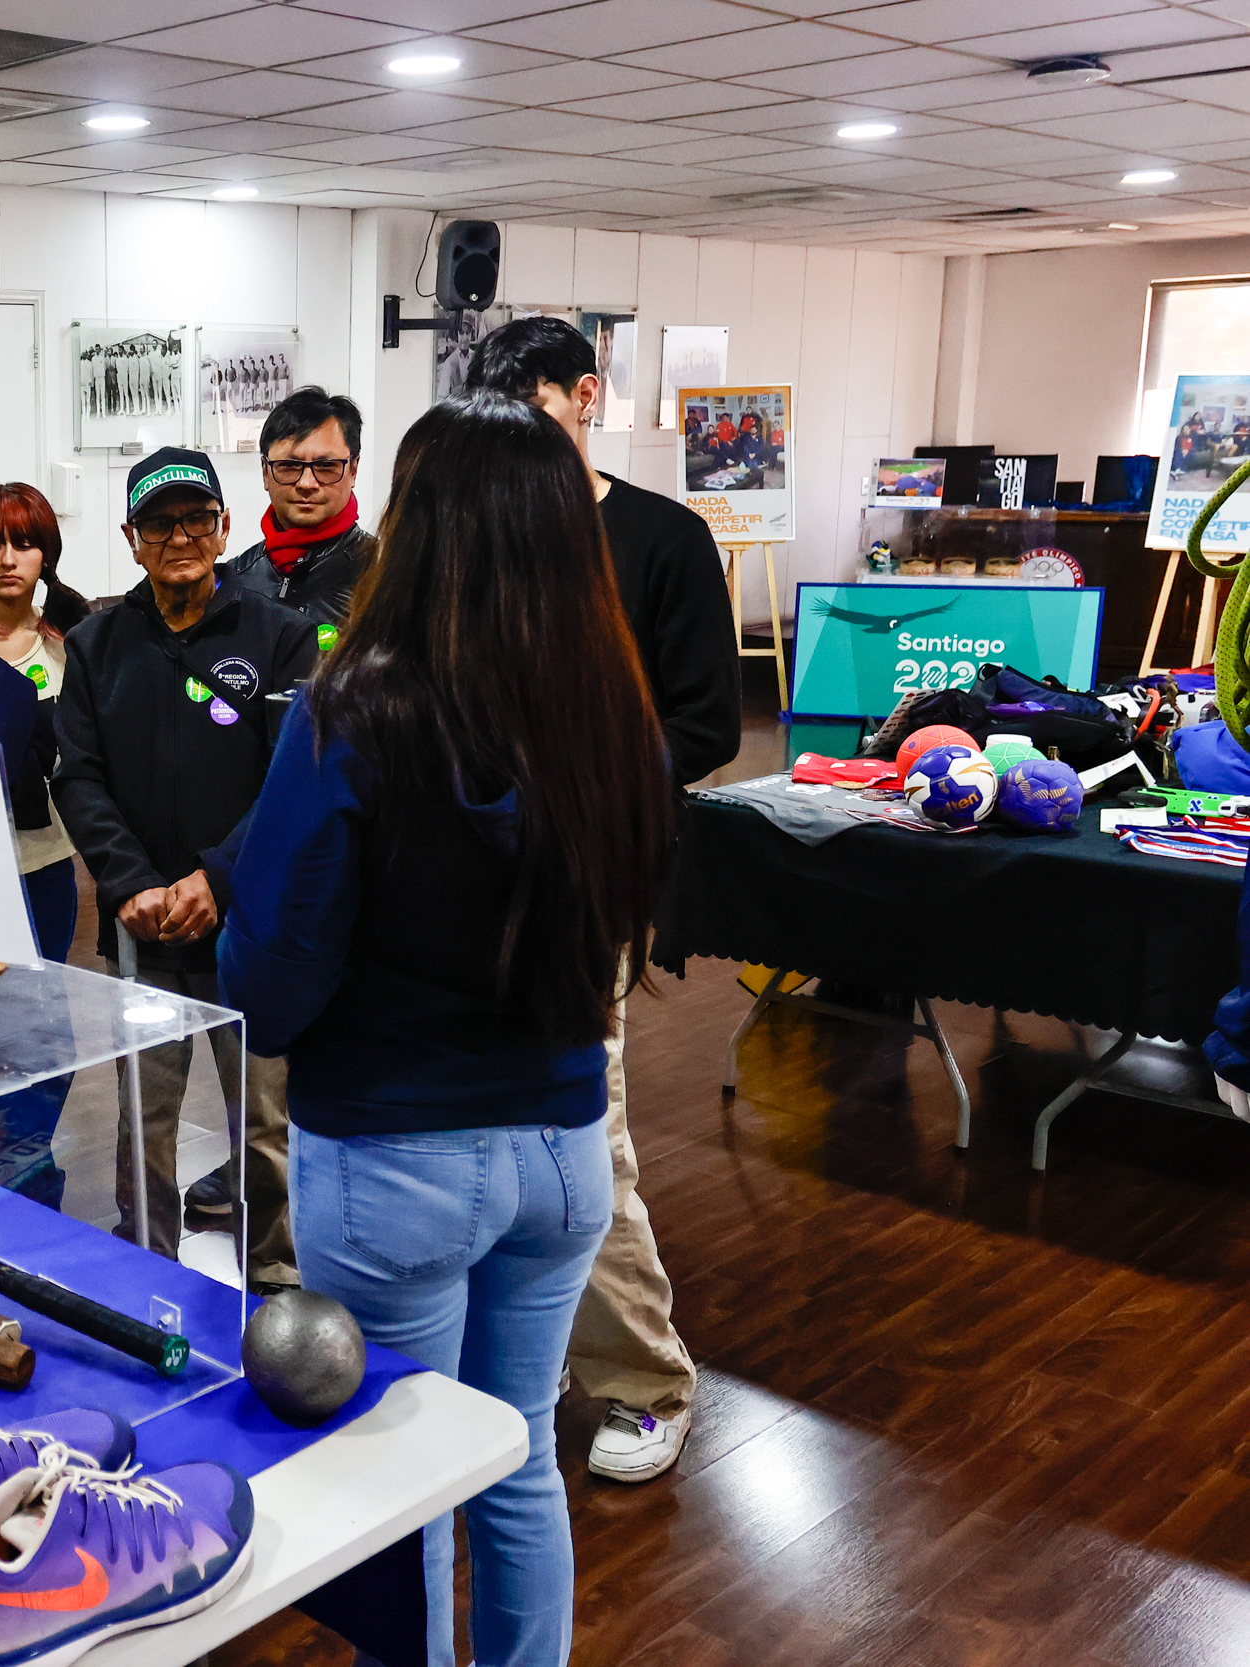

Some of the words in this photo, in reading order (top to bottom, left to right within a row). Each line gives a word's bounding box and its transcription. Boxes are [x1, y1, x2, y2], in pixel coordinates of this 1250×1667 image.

[994, 458, 1023, 478] SAN
[138, 470, 206, 497] CONTULMO
[686, 497, 728, 506] NADA
[1001, 492, 1020, 510] GO
[1164, 498, 1205, 508] NAD
[1203, 531, 1238, 541] ASA
[897, 632, 1005, 657] Santiago
[893, 659, 1004, 693] 202
